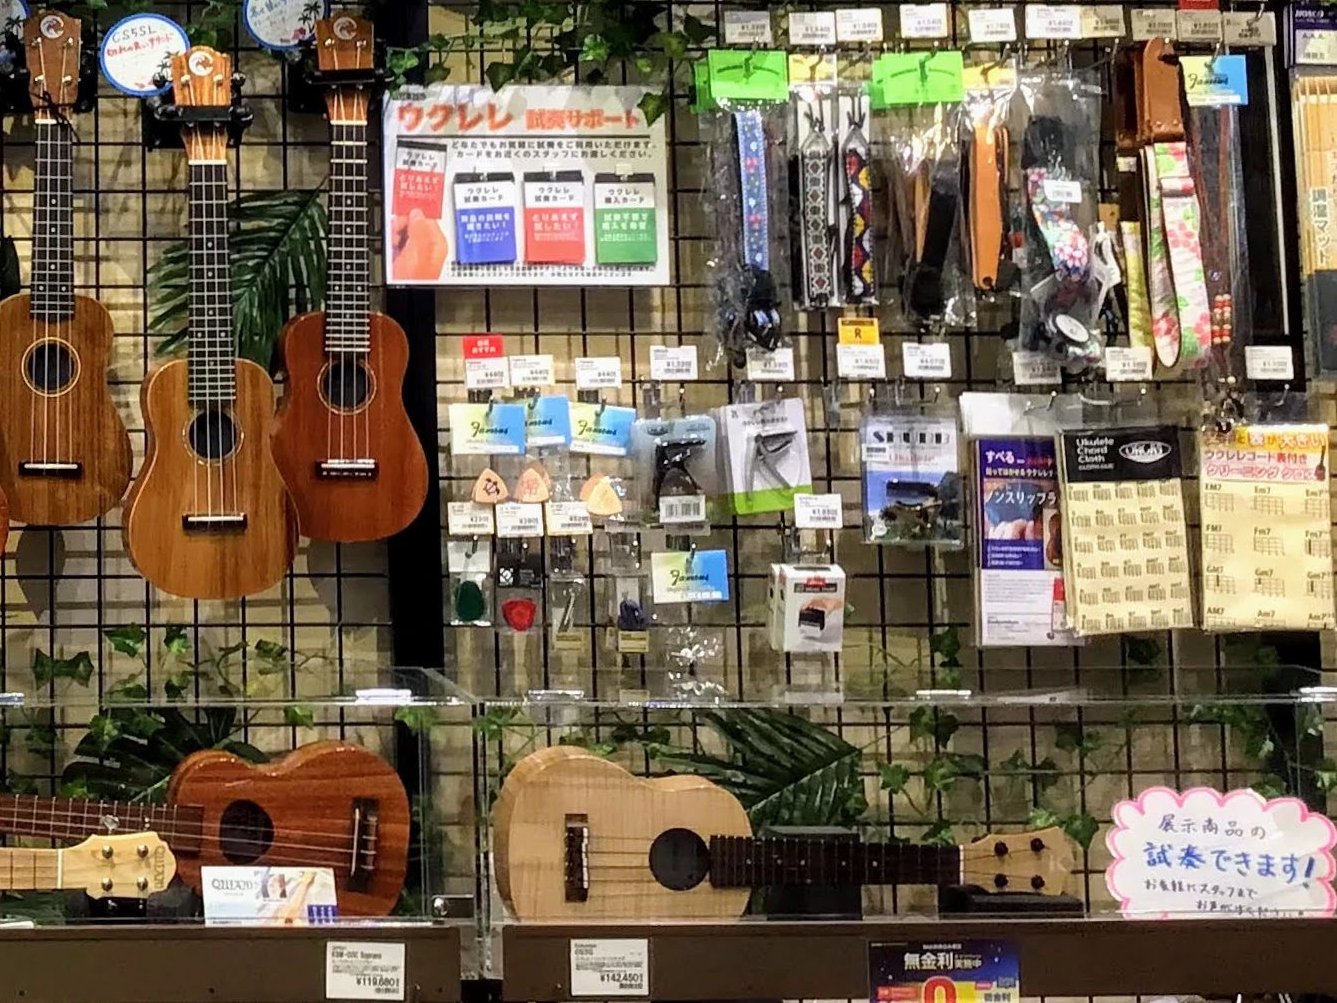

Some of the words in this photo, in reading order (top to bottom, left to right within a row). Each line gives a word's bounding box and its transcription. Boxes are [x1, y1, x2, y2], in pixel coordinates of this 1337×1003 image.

[112, 24, 158, 44] CS5SL
[397, 102, 515, 133] ウクレレ
[470, 420, 509, 438] Famous
[577, 419, 618, 436] Famous
[1076, 437, 1115, 447] Ukulele
[985, 450, 1015, 464] すべる
[1077, 446, 1108, 456] Chord
[1077, 455, 1106, 464] Cloth
[1254, 486, 1271, 494] Em7
[1205, 524, 1223, 532] FM7
[1254, 527, 1271, 535] Fm7
[669, 569, 710, 587] Famous
[1254, 568, 1274, 577] Gm7
[1257, 609, 1276, 617] Am7
[1157, 813, 1266, 840] 展示商品の
[1142, 841, 1316, 890] 試奏できます！
[1143, 878, 1258, 900] お気軽にスタッフまで
[903, 951, 954, 971] 無金利
